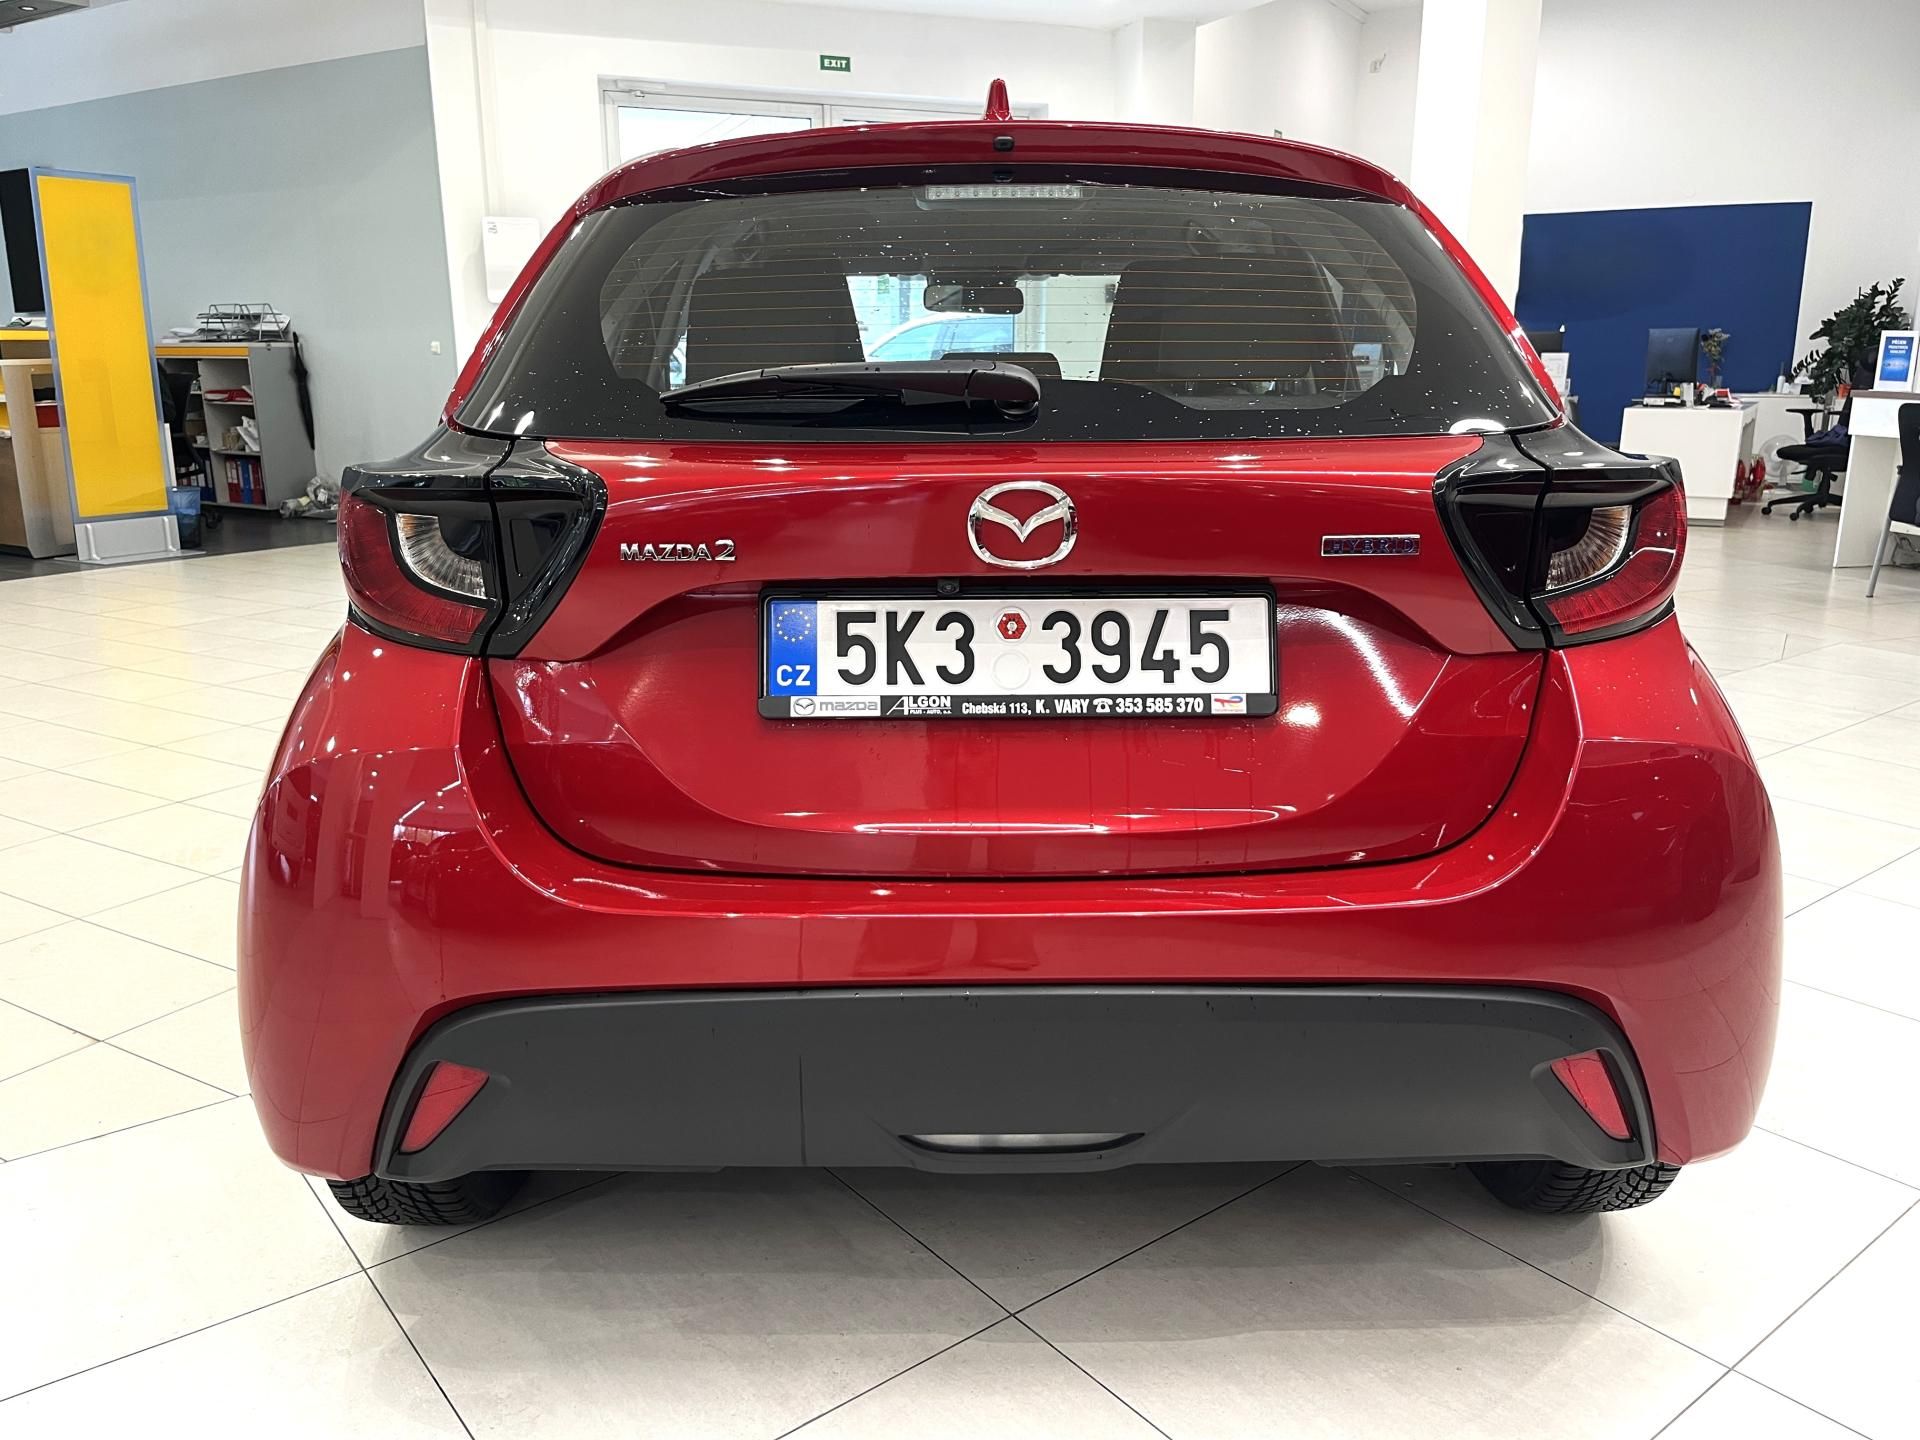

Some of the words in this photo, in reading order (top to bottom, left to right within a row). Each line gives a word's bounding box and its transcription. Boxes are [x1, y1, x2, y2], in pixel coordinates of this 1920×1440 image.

[824, 58, 848, 68] EXIT
[1329, 538, 1417, 554] HYBRID
[836, 611, 975, 685] 5K3
[1042, 610, 1230, 683] 3945
[776, 664, 811, 686] CZ
[886, 696, 952, 715] ALGON
[962, 702, 1007, 714] Chebská
[1009, 702, 1032, 715] 113,
[1035, 699, 1050, 714] K.
[1054, 698, 1090, 714] VARY
[1115, 698, 1143, 713] 353
[1146, 698, 1174, 713] 585
[1176, 697, 1204, 713] 370
